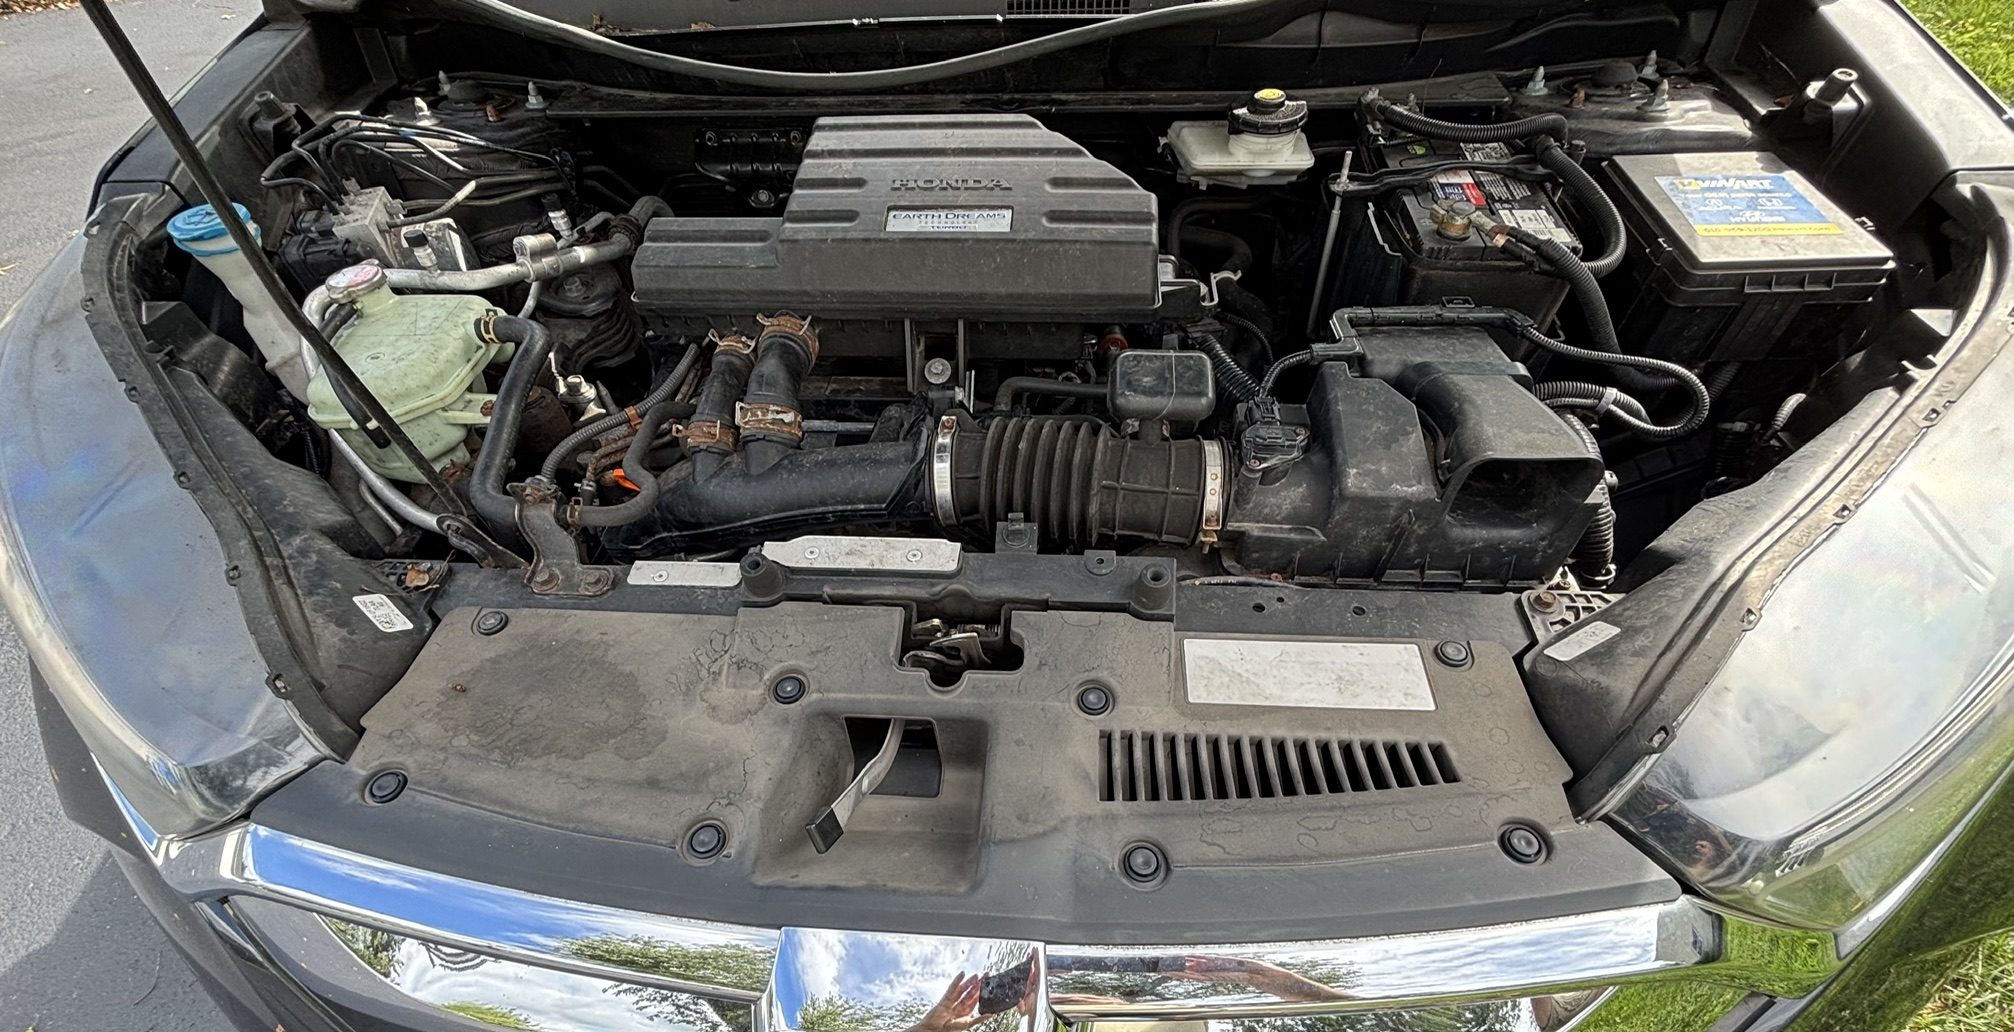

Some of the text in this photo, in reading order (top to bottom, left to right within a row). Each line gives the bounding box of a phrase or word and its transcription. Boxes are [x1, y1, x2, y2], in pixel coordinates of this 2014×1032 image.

[890, 178, 1013, 191] HONDA
[892, 212, 1006, 220] EARTH DREAMS
